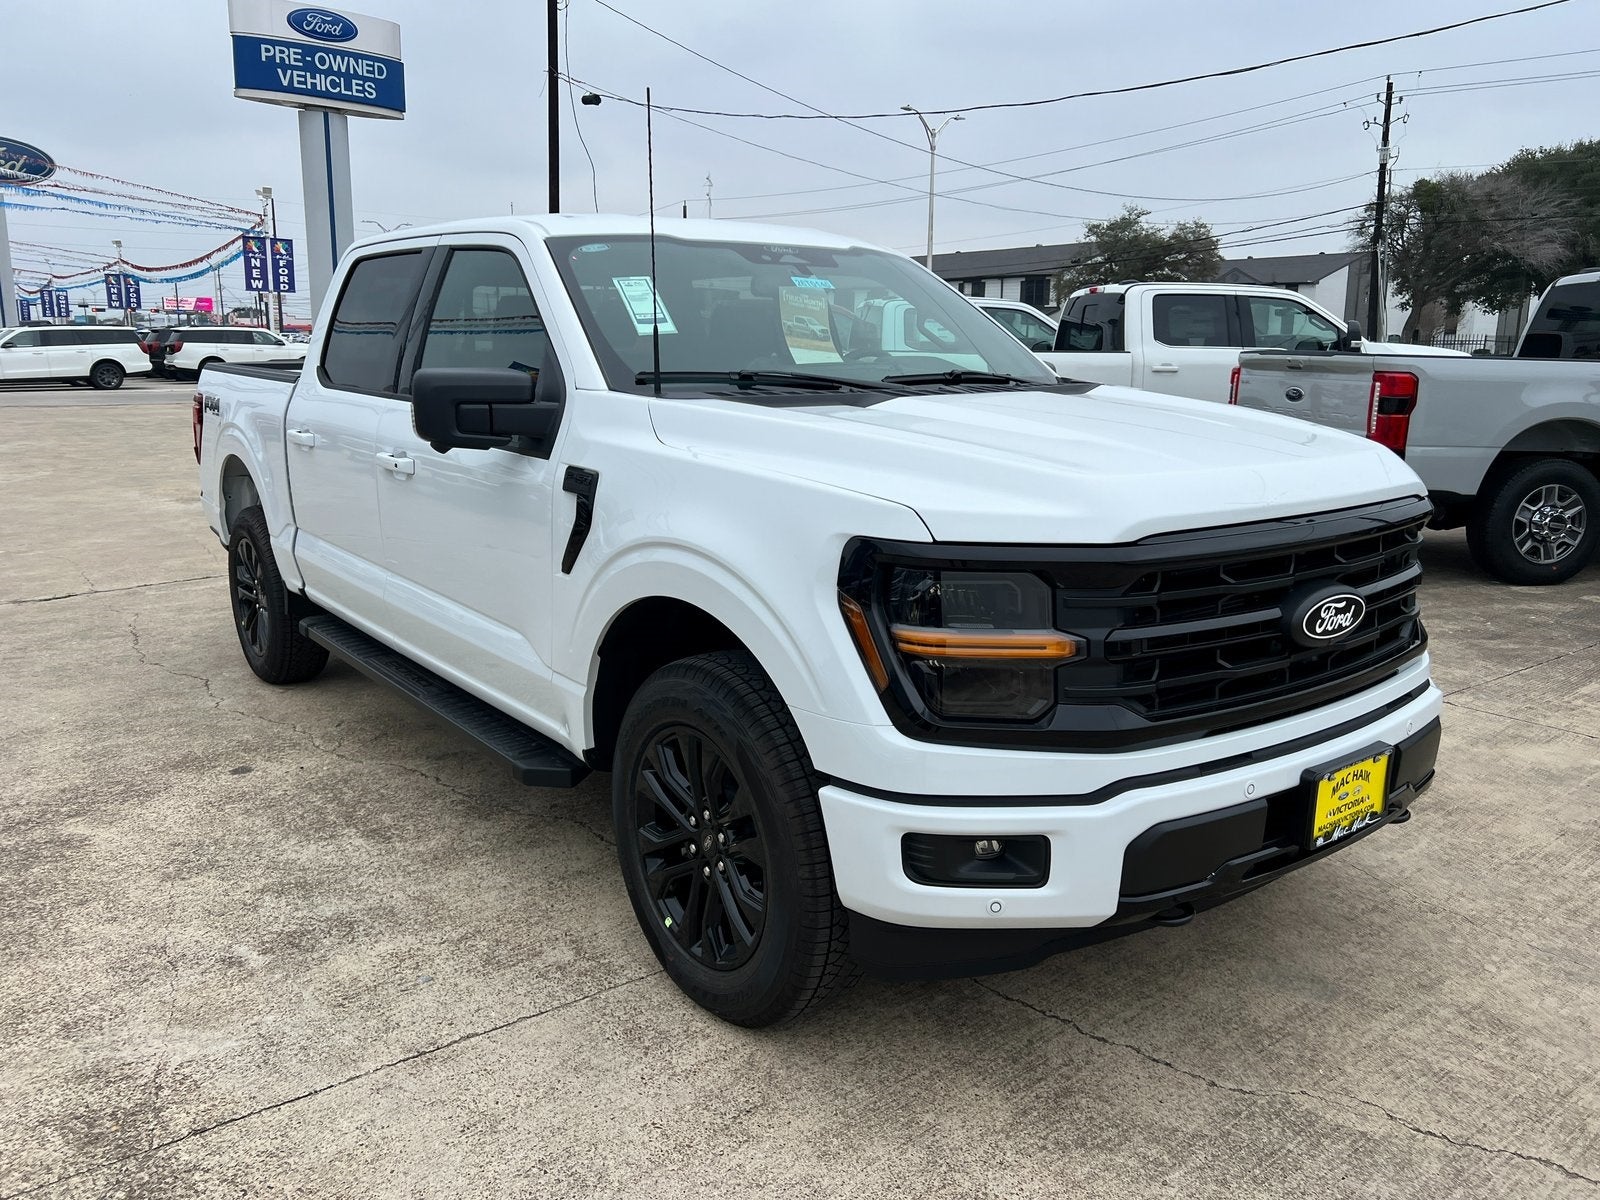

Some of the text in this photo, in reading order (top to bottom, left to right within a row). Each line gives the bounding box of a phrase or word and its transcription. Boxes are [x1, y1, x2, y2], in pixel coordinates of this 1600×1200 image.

[302, 12, 343, 36] Ford
[277, 68, 377, 99] VEHICLES
[250, 258, 264, 289] NEW
[278, 259, 290, 291] FORD
[109, 287, 121, 308] NEW
[128, 287, 138, 308] FORD
[1315, 600, 1356, 634] Ford
[1331, 772, 1351, 799] MAC
[1352, 768, 1371, 784] HAIK
